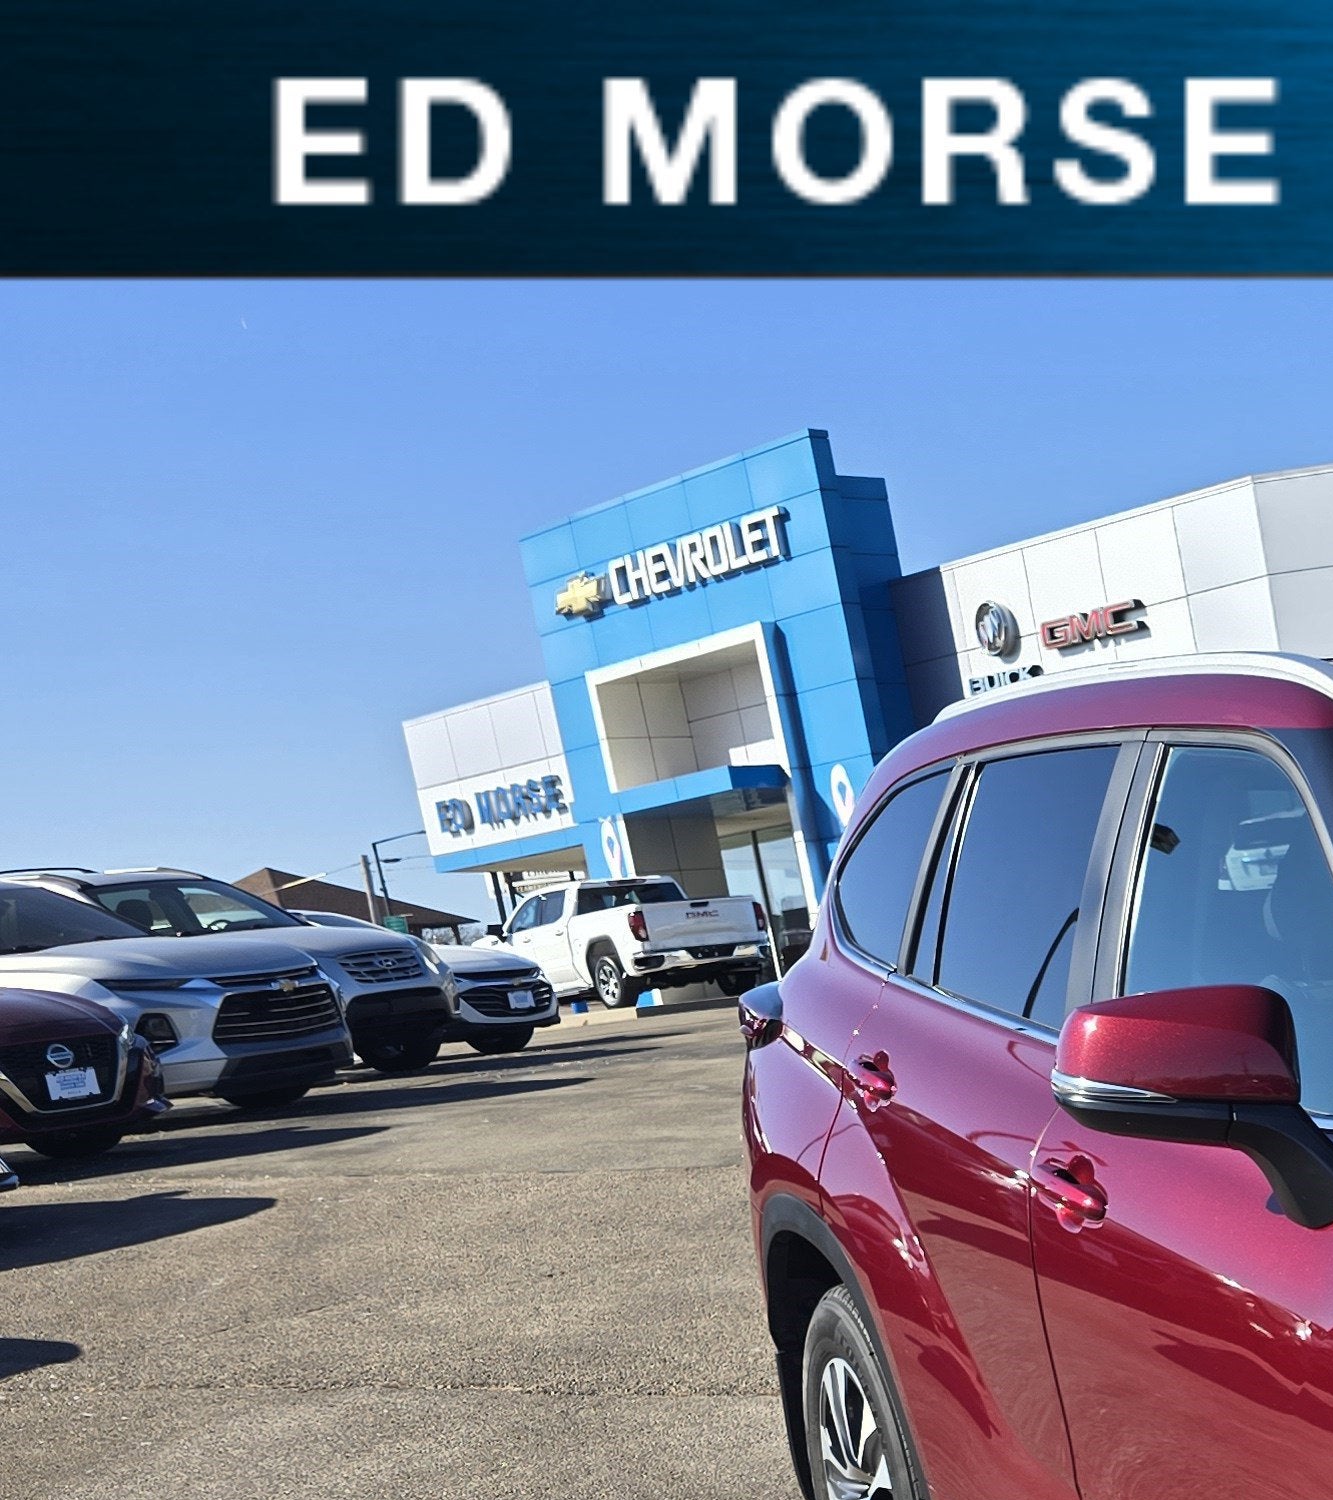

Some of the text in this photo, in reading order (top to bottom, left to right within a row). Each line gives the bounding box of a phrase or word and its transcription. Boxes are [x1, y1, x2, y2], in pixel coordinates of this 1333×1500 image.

[608, 506, 783, 605] CHEVROLET
[1040, 600, 1139, 650] GMC
[970, 664, 1037, 695] BUICK
[436, 798, 472, 836] ED
